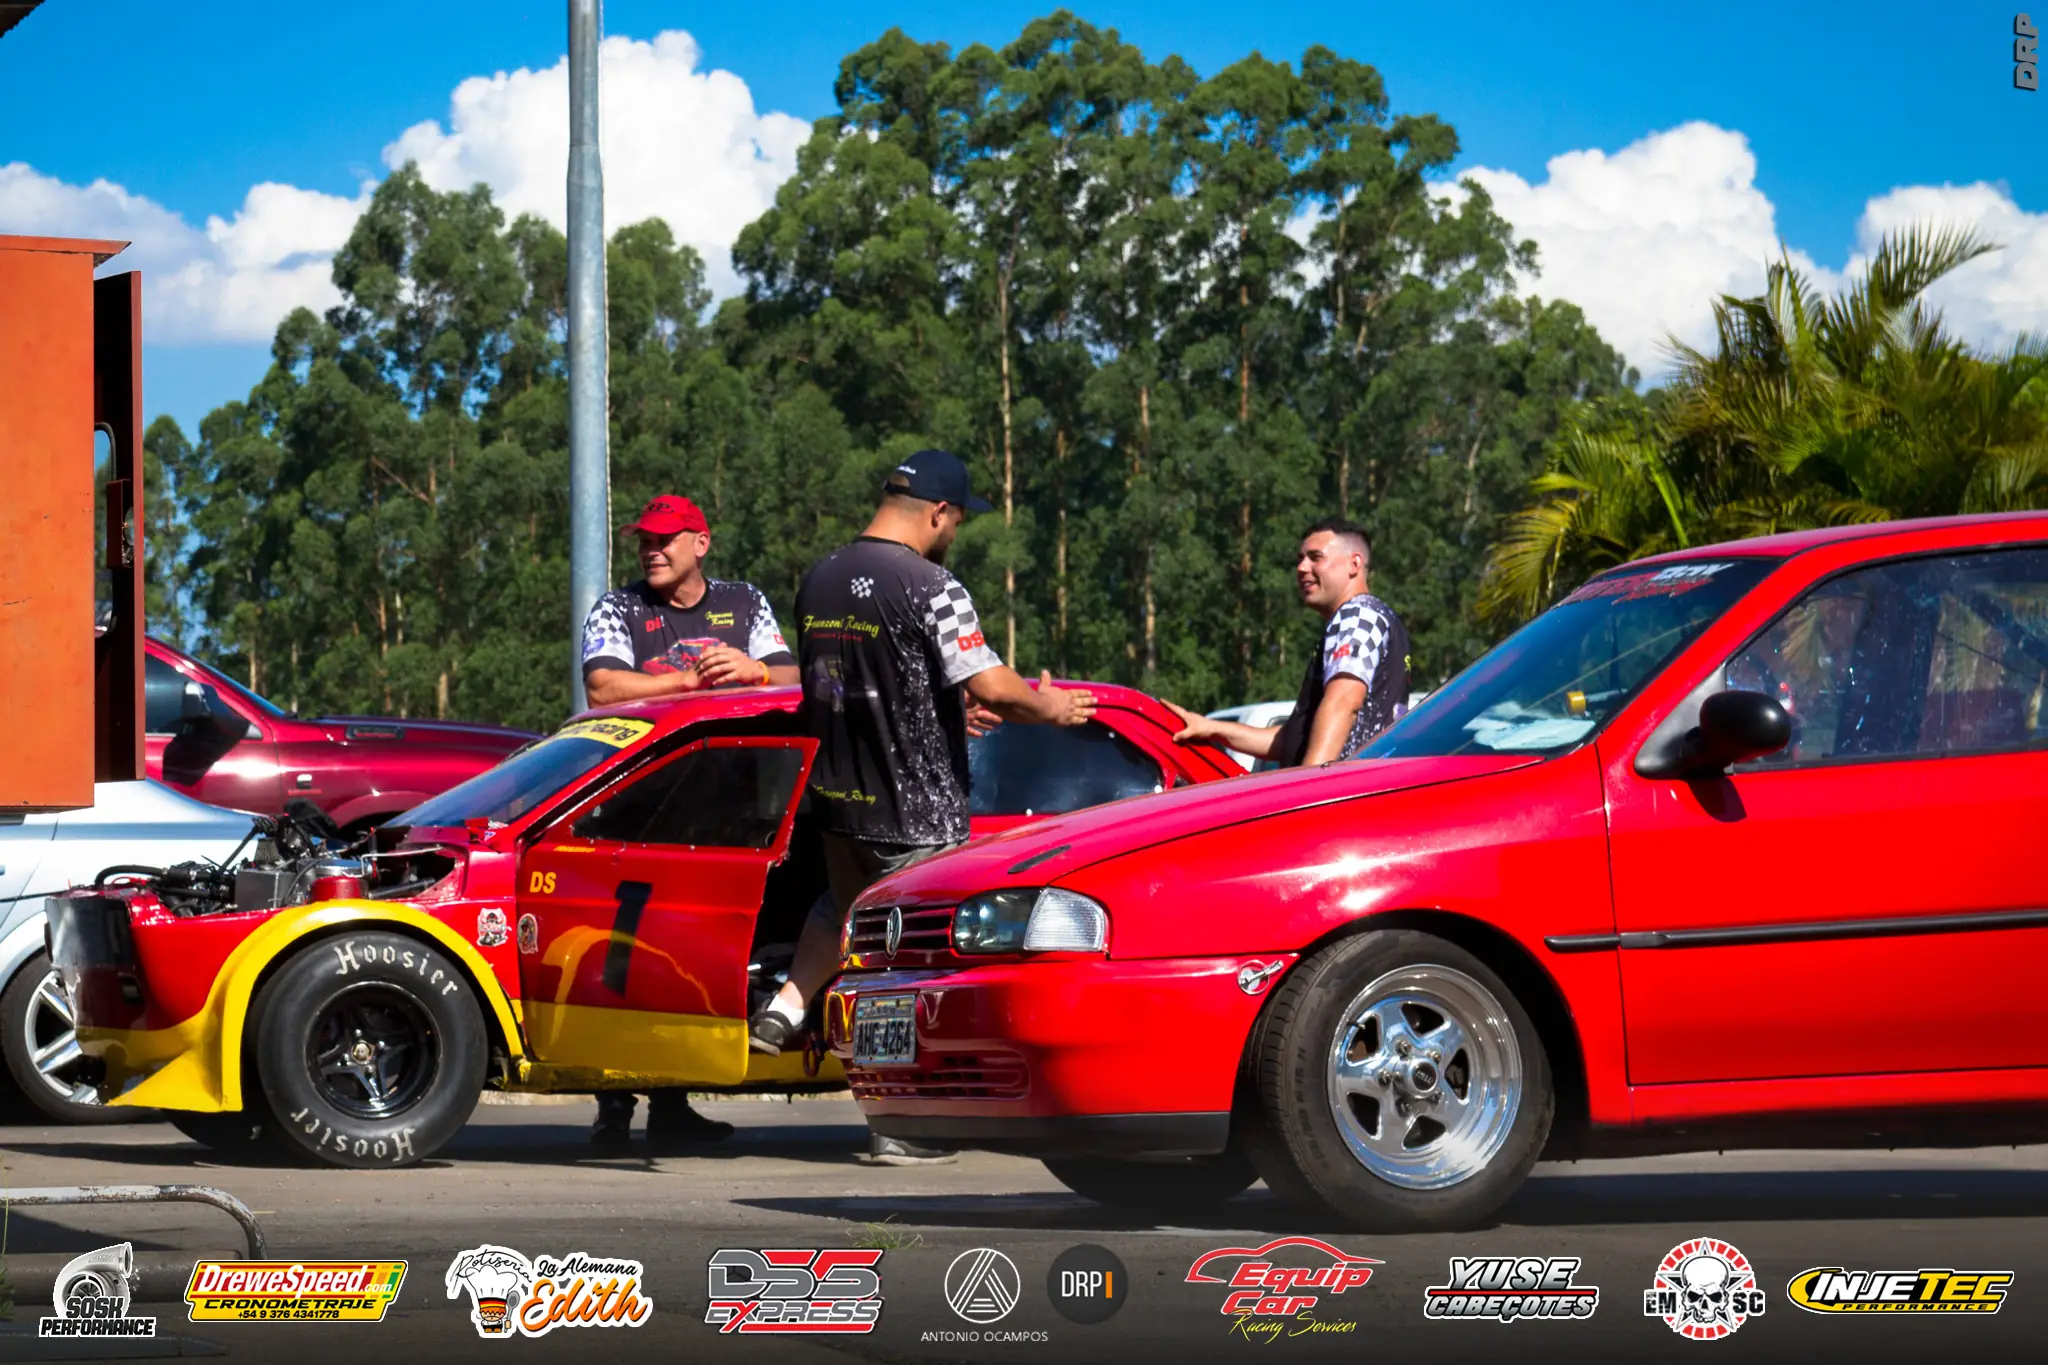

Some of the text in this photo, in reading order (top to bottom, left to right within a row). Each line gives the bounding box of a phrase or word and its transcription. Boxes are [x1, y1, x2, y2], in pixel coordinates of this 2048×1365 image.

[957, 631, 985, 652] DS
[529, 871, 557, 894] DS
[334, 941, 458, 995] Hoosier
[291, 1107, 416, 1162] Hoosier
